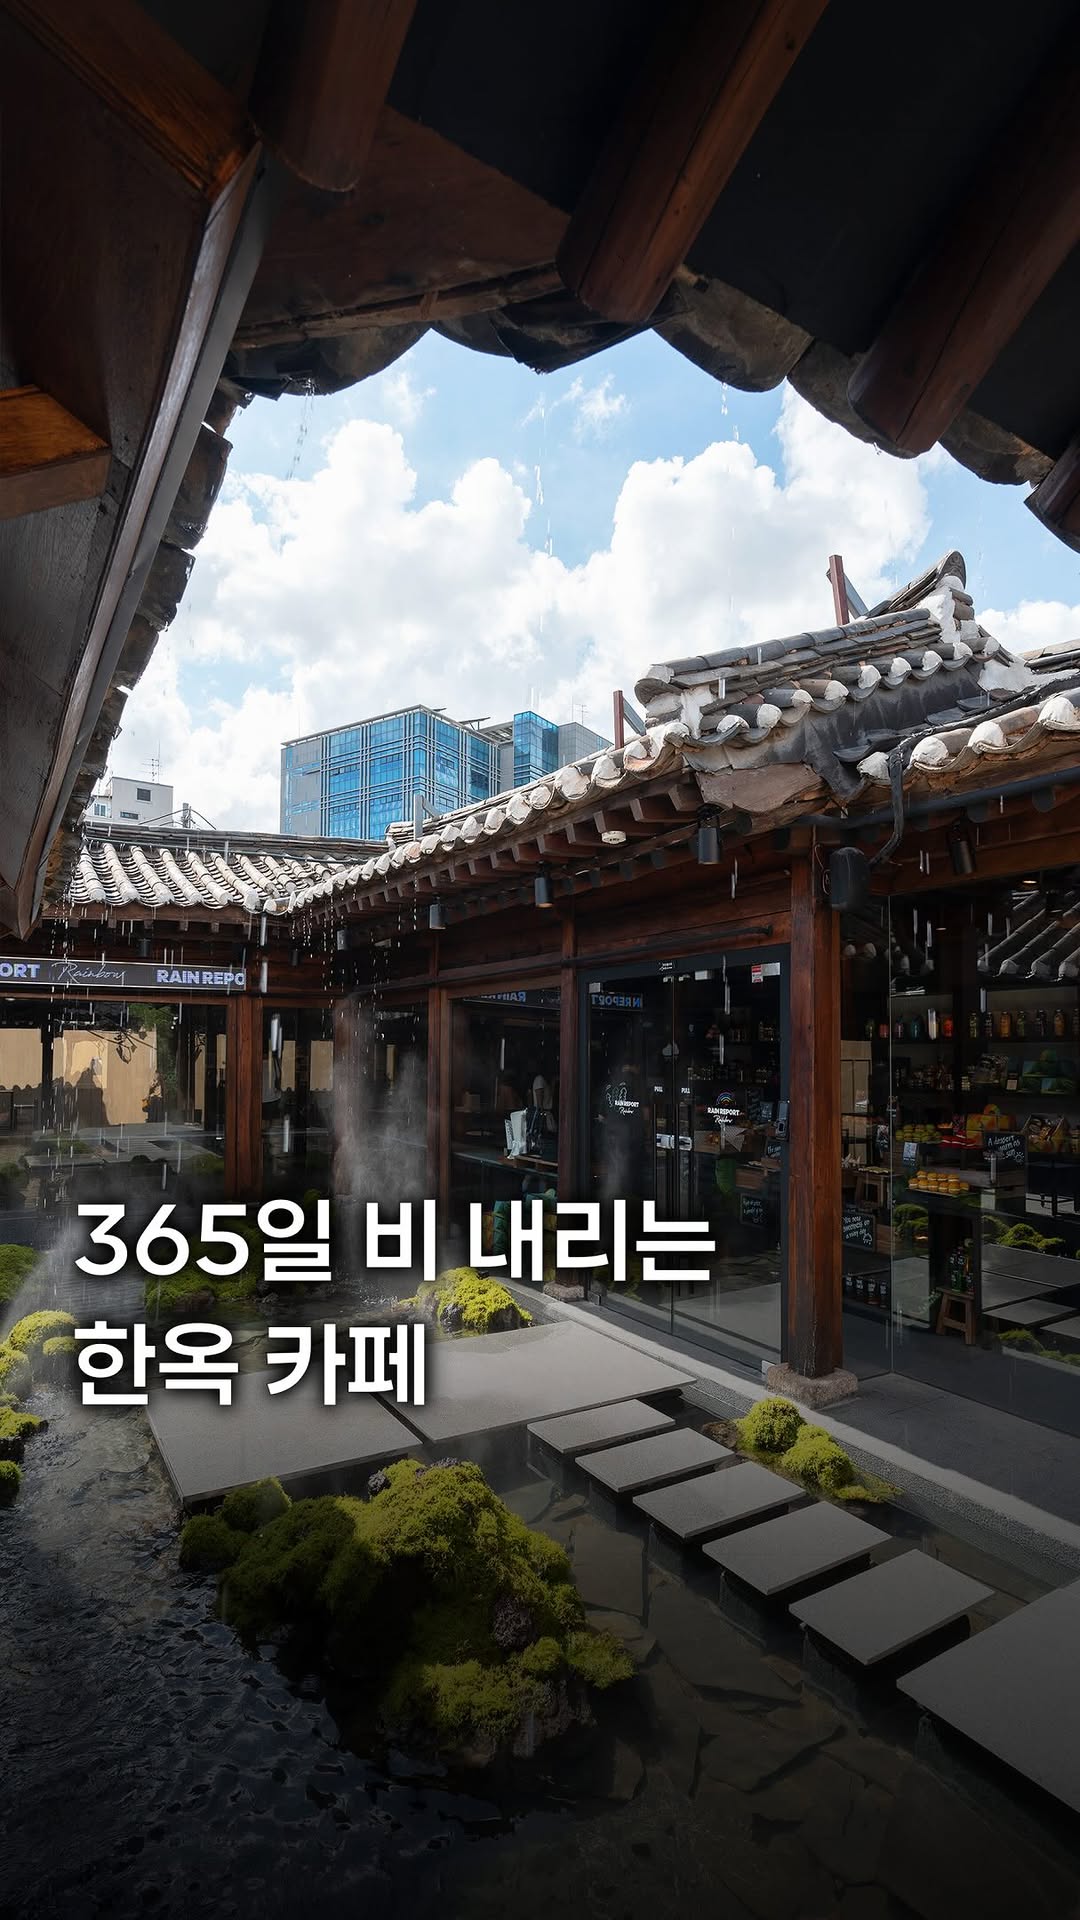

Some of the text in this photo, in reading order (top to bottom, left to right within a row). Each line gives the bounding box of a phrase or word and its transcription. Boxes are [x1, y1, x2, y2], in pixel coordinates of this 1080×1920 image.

[0, 963, 40, 978] ORT
[156, 969, 200, 985] RAIN
[202, 970, 245, 986] REPO
[719, 1108, 740, 1116] REPORT
